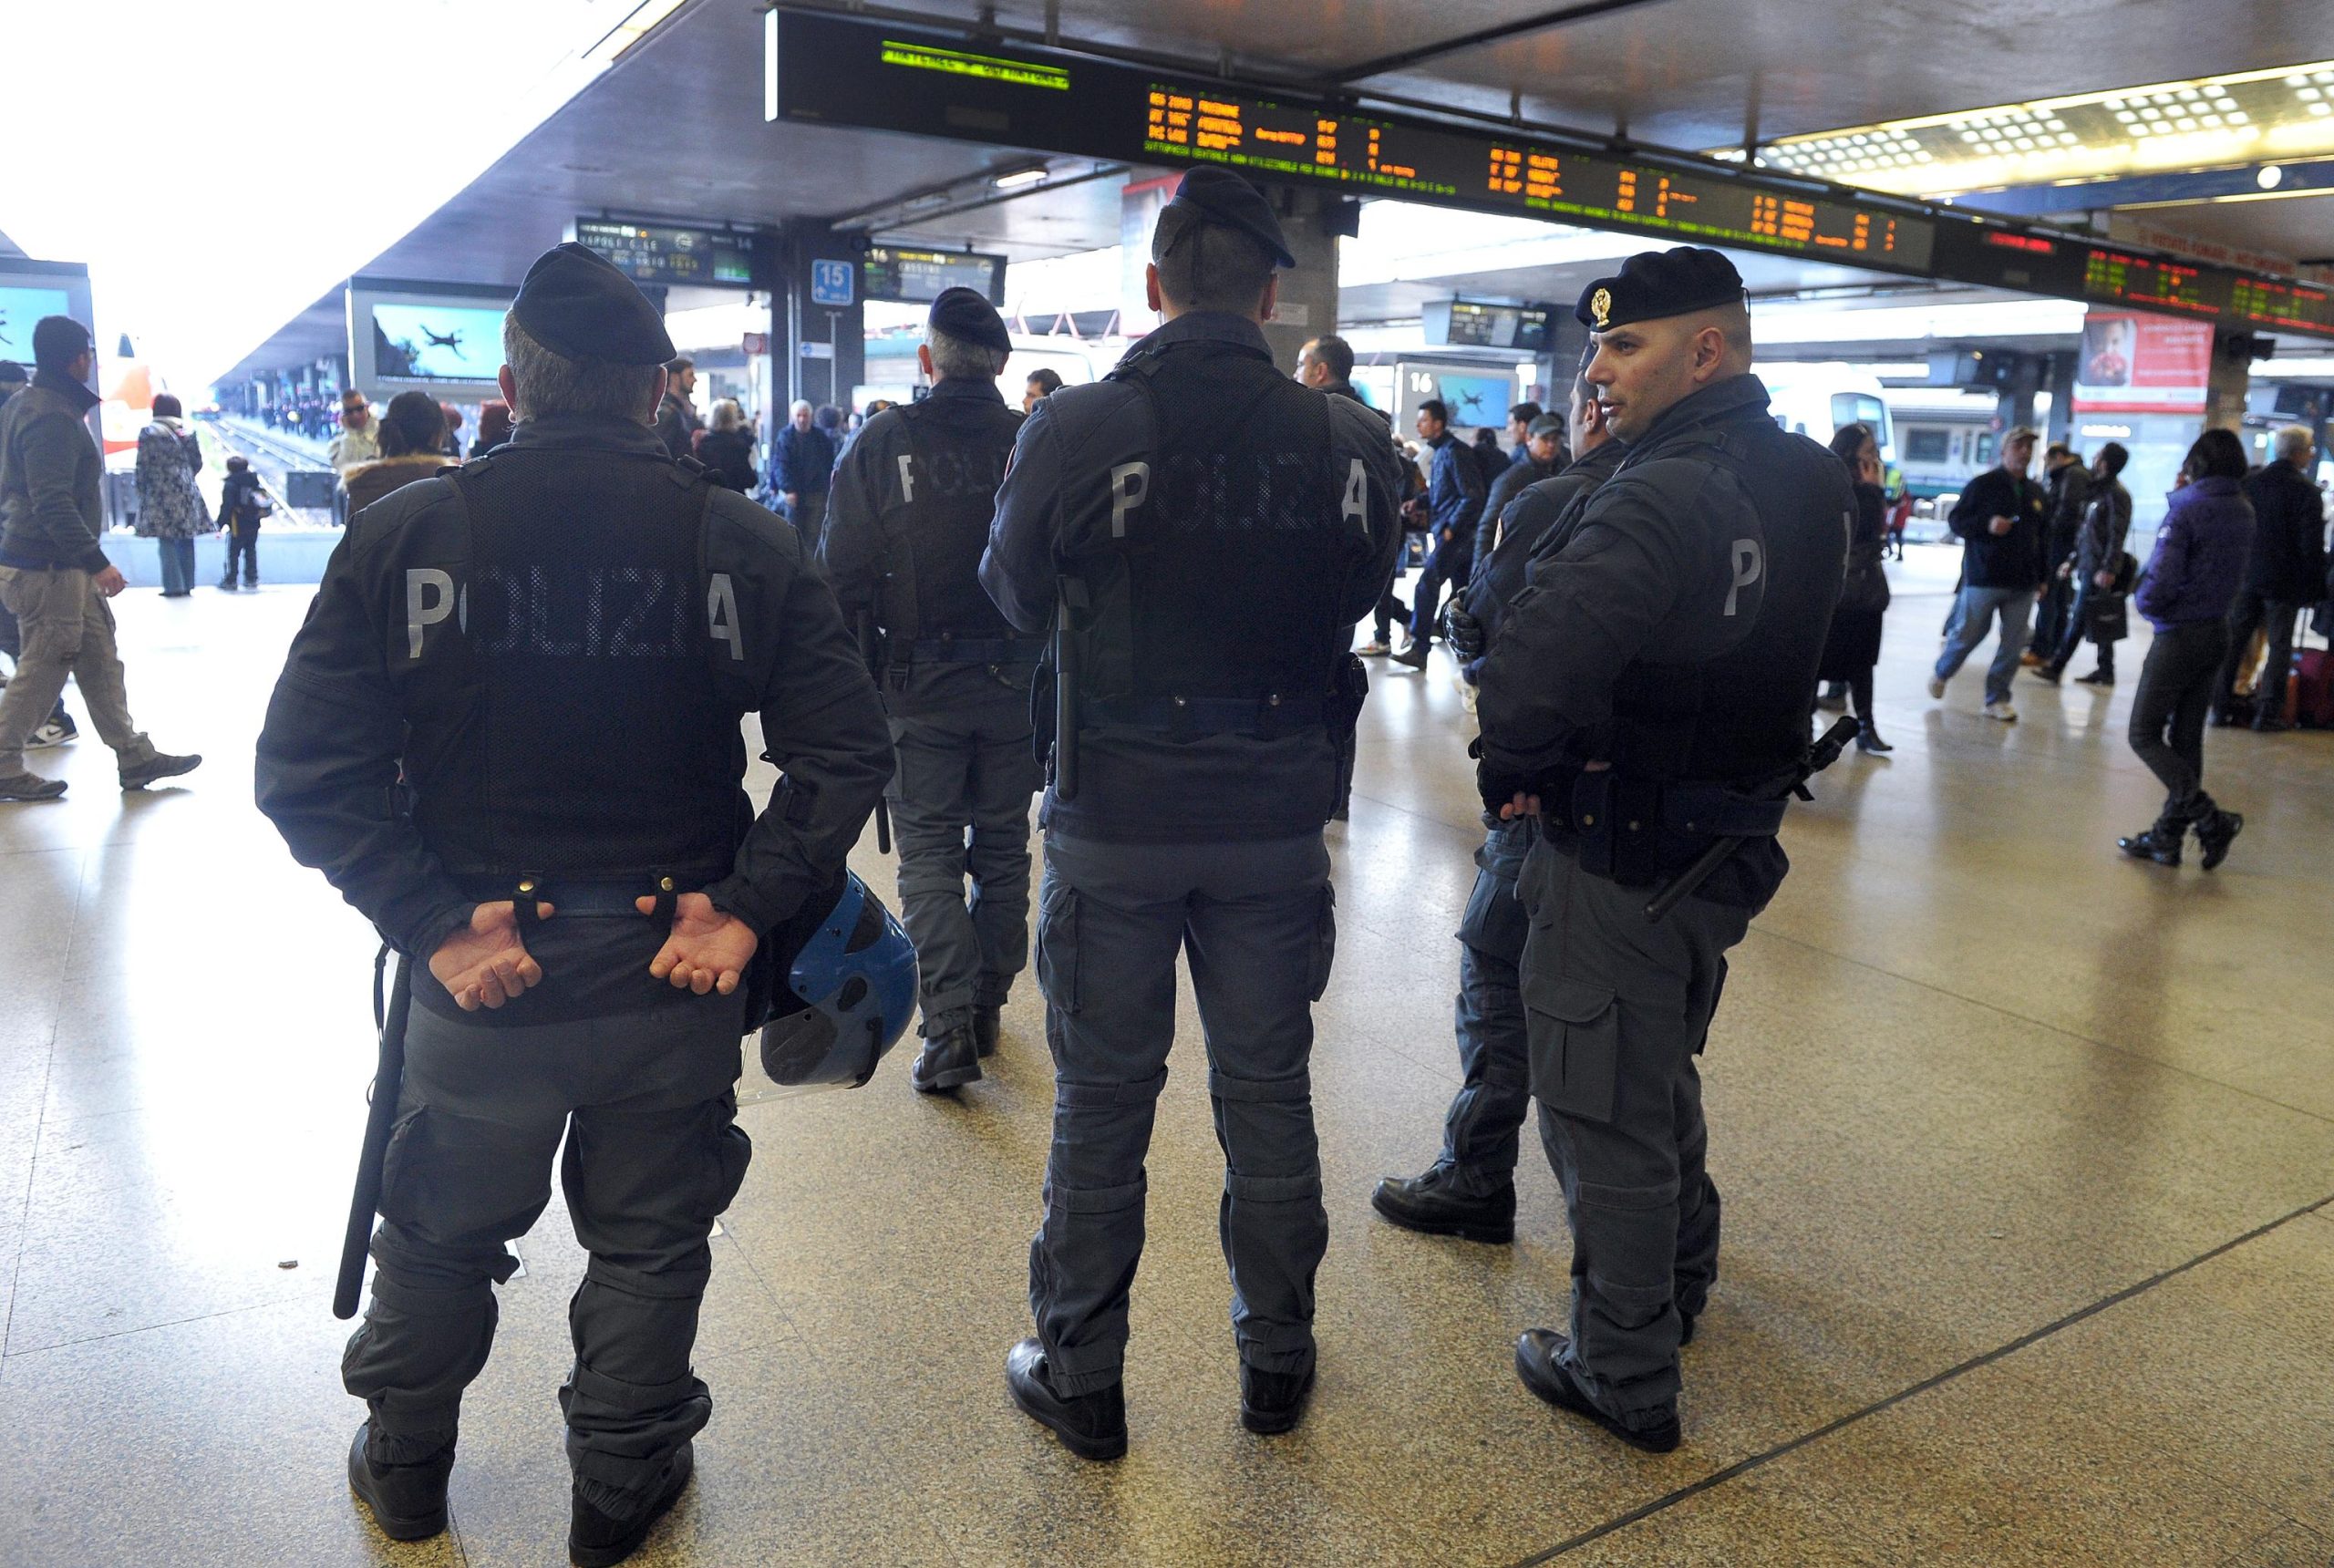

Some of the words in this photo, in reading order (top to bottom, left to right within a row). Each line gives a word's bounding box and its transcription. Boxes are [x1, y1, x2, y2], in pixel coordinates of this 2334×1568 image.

[871, 249, 888, 263] 16
[821, 265, 845, 288] 15
[1410, 372, 1432, 393] 16
[407, 564, 744, 661] POLIZIA
